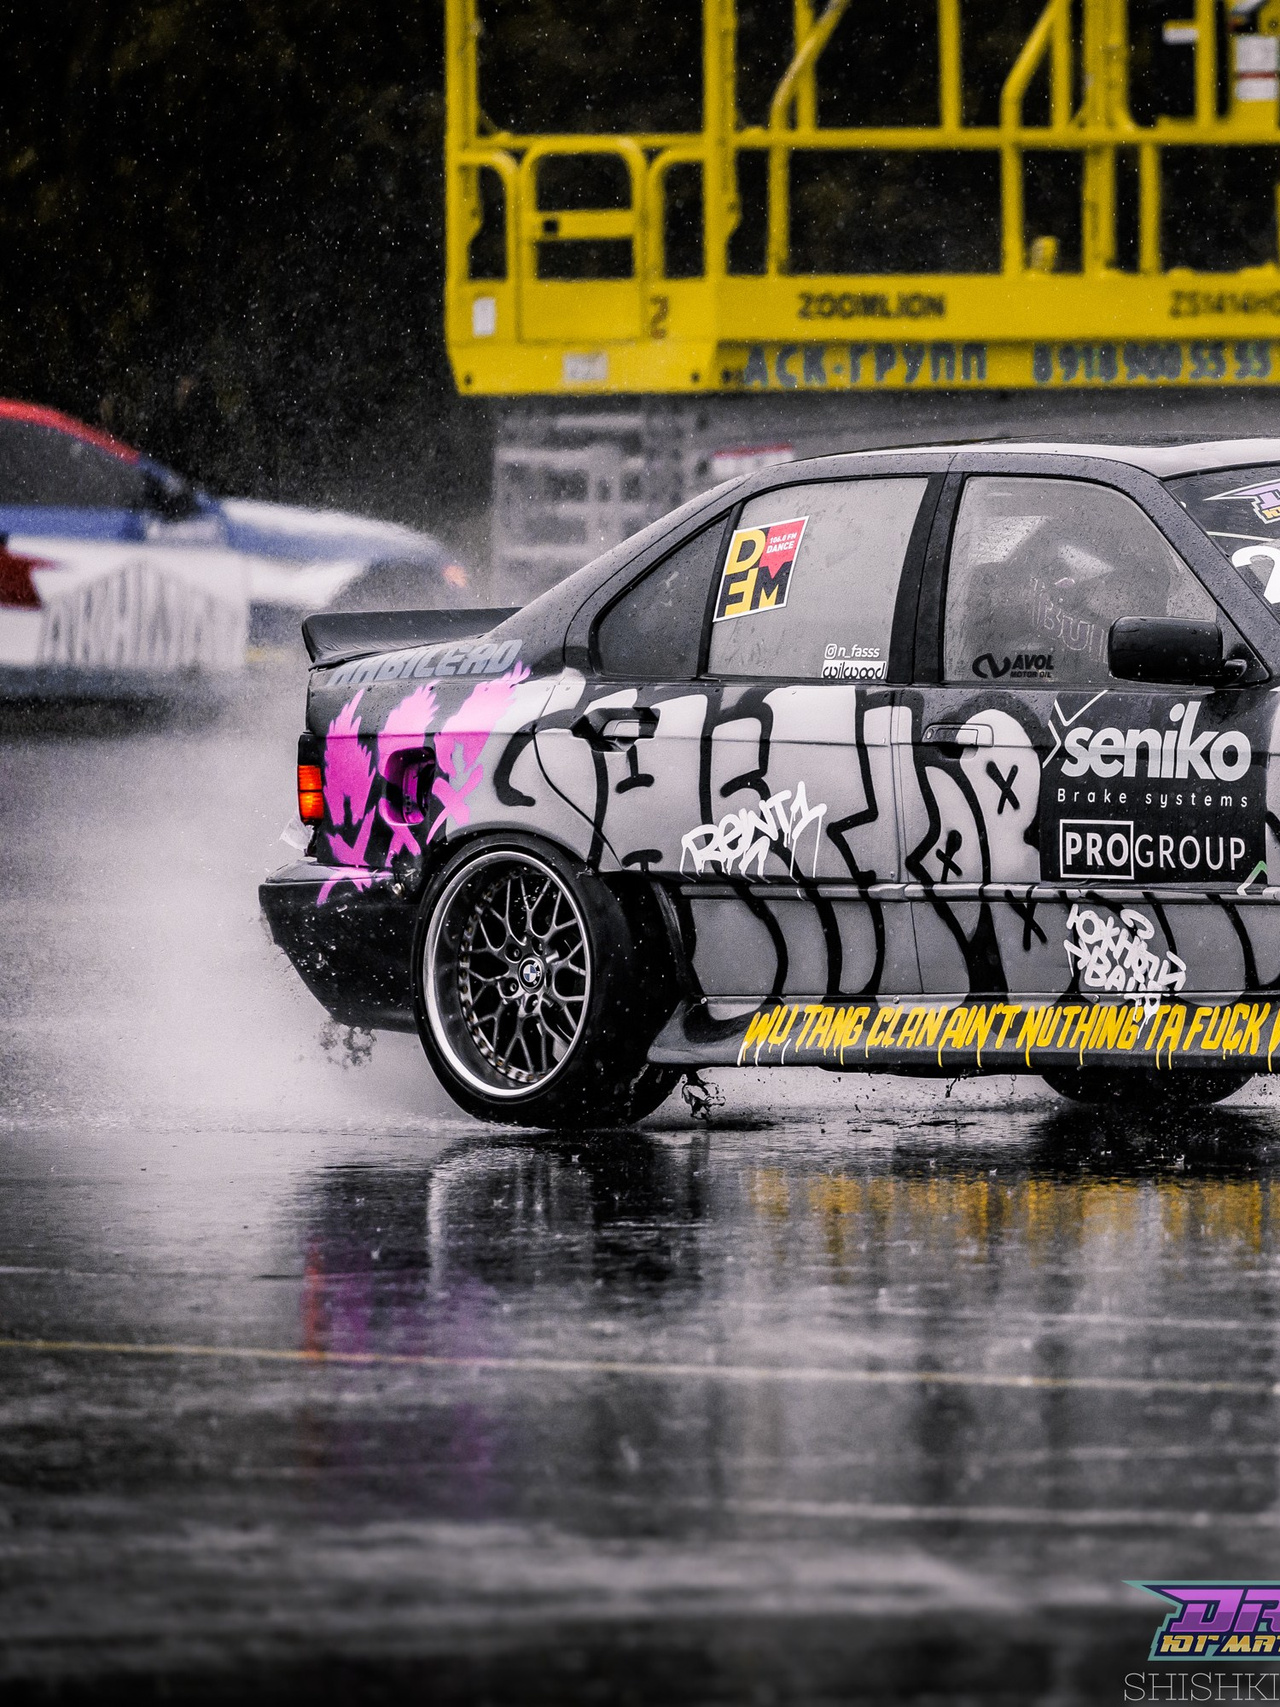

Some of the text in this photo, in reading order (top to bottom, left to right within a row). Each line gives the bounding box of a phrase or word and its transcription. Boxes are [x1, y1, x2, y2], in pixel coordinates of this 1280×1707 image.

[798, 292, 948, 319] ZOOMLION
[766, 541, 795, 554] DANCE
[1060, 701, 1252, 782] seniko
[1057, 788, 1248, 808] Brake systems
[742, 1004, 798, 1050] WU
[796, 1004, 870, 1050] TANG
[867, 1005, 948, 1050] CLAN
[1016, 1004, 1142, 1051] NUTHING
[1144, 1004, 1187, 1051] TA
[1183, 1003, 1271, 1054] FUCK
